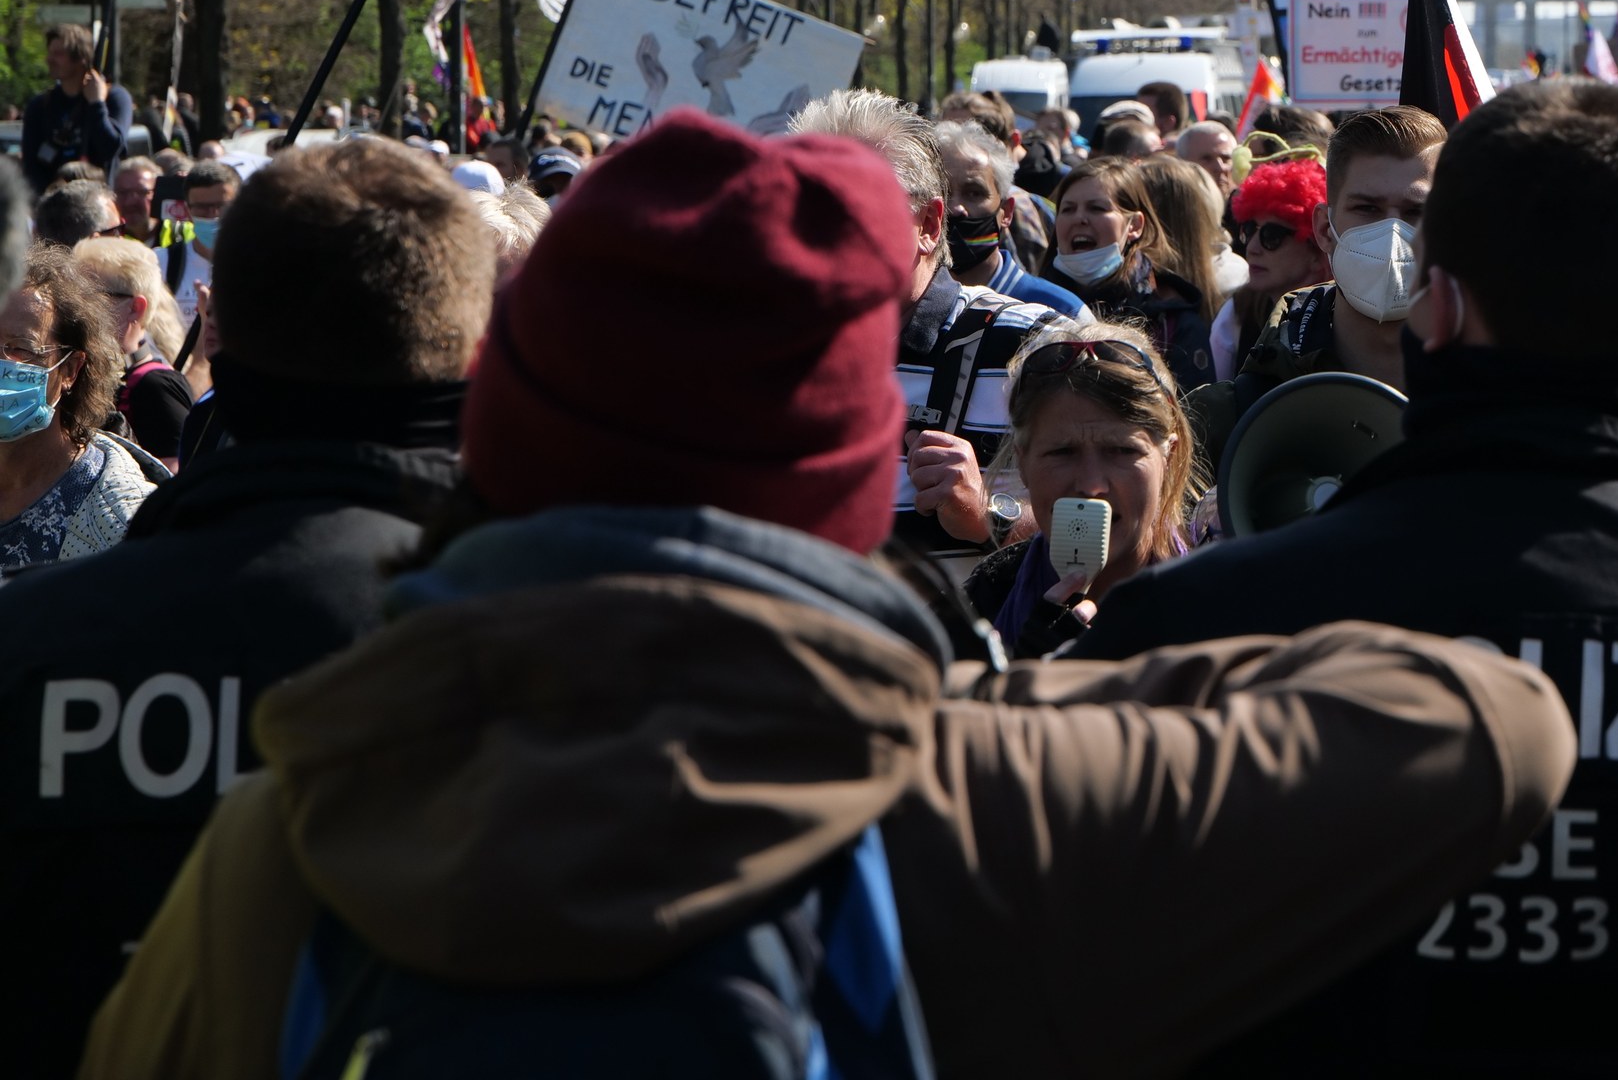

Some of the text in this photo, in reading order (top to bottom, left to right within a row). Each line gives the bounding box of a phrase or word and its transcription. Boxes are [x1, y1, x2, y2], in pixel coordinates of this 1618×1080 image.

[1307, 2, 1350, 18] Nein
[570, 56, 614, 88] DIE
[1340, 75, 1402, 91] Gesetz
